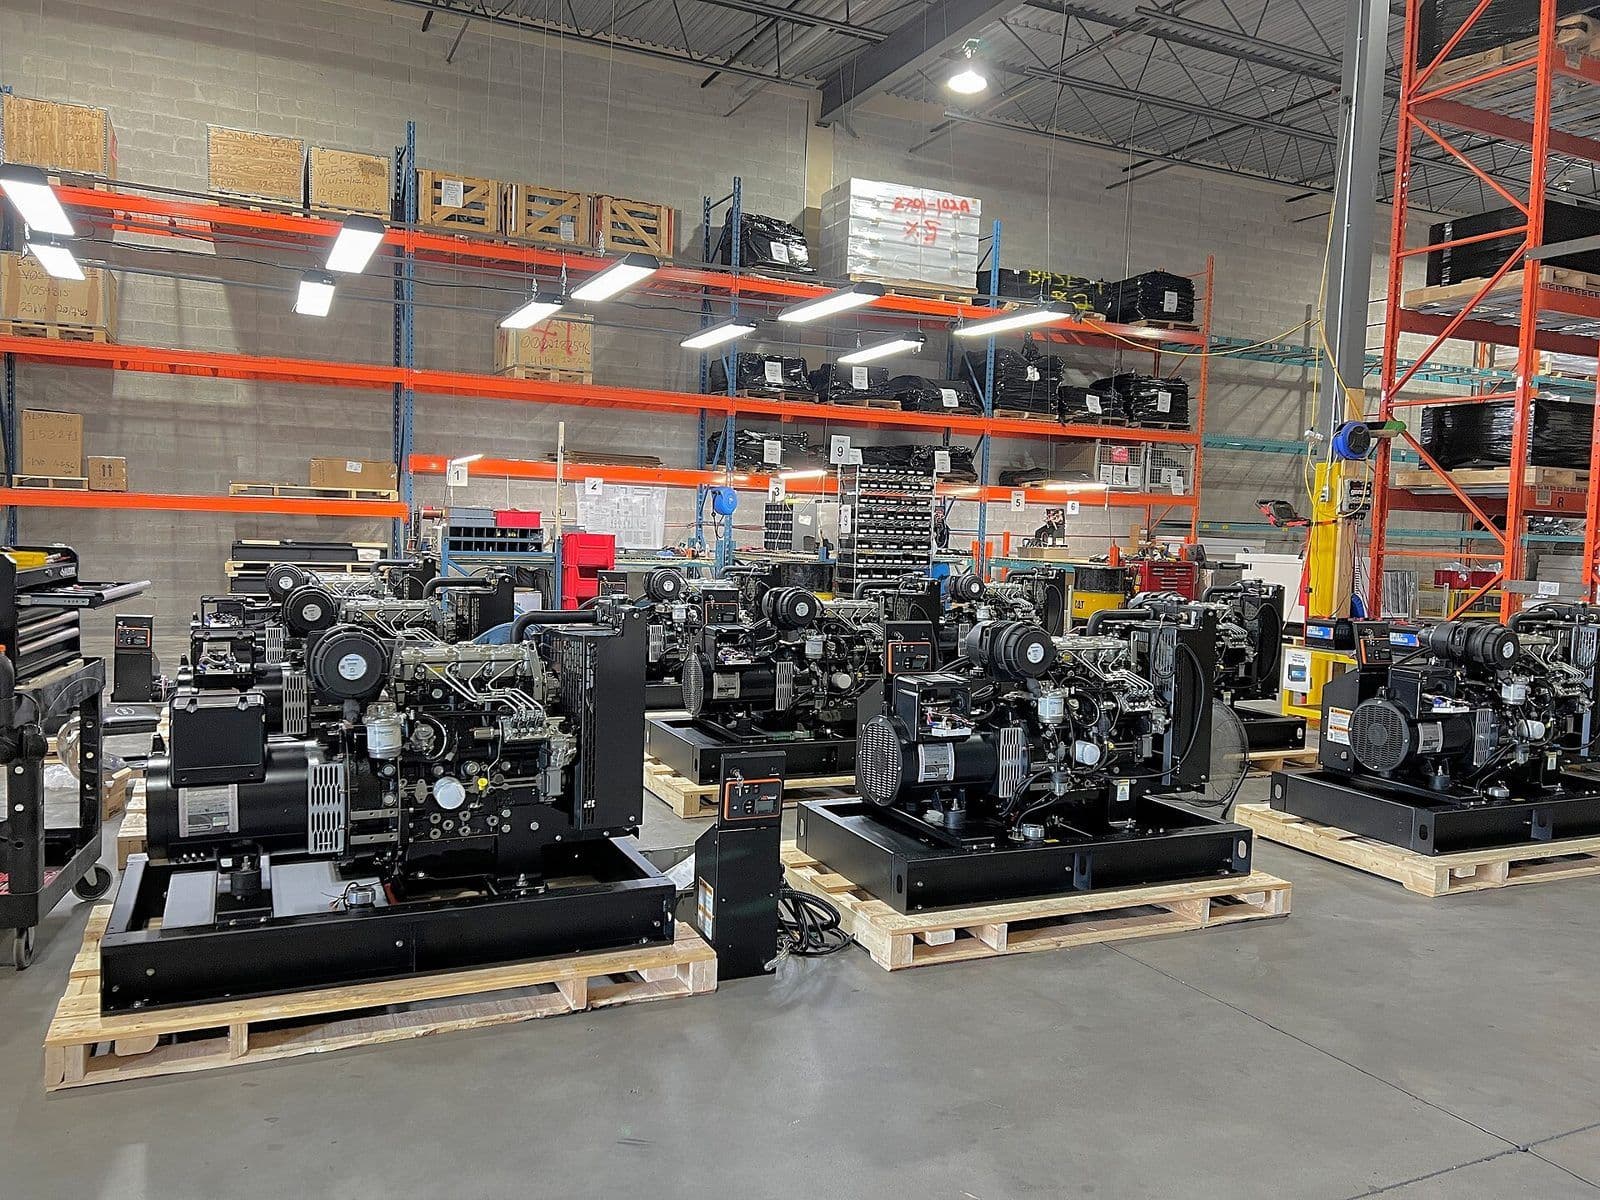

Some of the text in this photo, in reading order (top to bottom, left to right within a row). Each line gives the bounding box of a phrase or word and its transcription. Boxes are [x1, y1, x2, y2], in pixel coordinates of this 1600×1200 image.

[837, 446, 844, 457] 9
[454, 470, 460, 481] 1
[1166, 474, 1171, 482] 3
[590, 481, 597, 490] 2
[774, 487, 780, 496] 3
[1015, 498, 1021, 507] 5
[1070, 503, 1076, 511] 6
[1075, 600, 1084, 609] CAT
